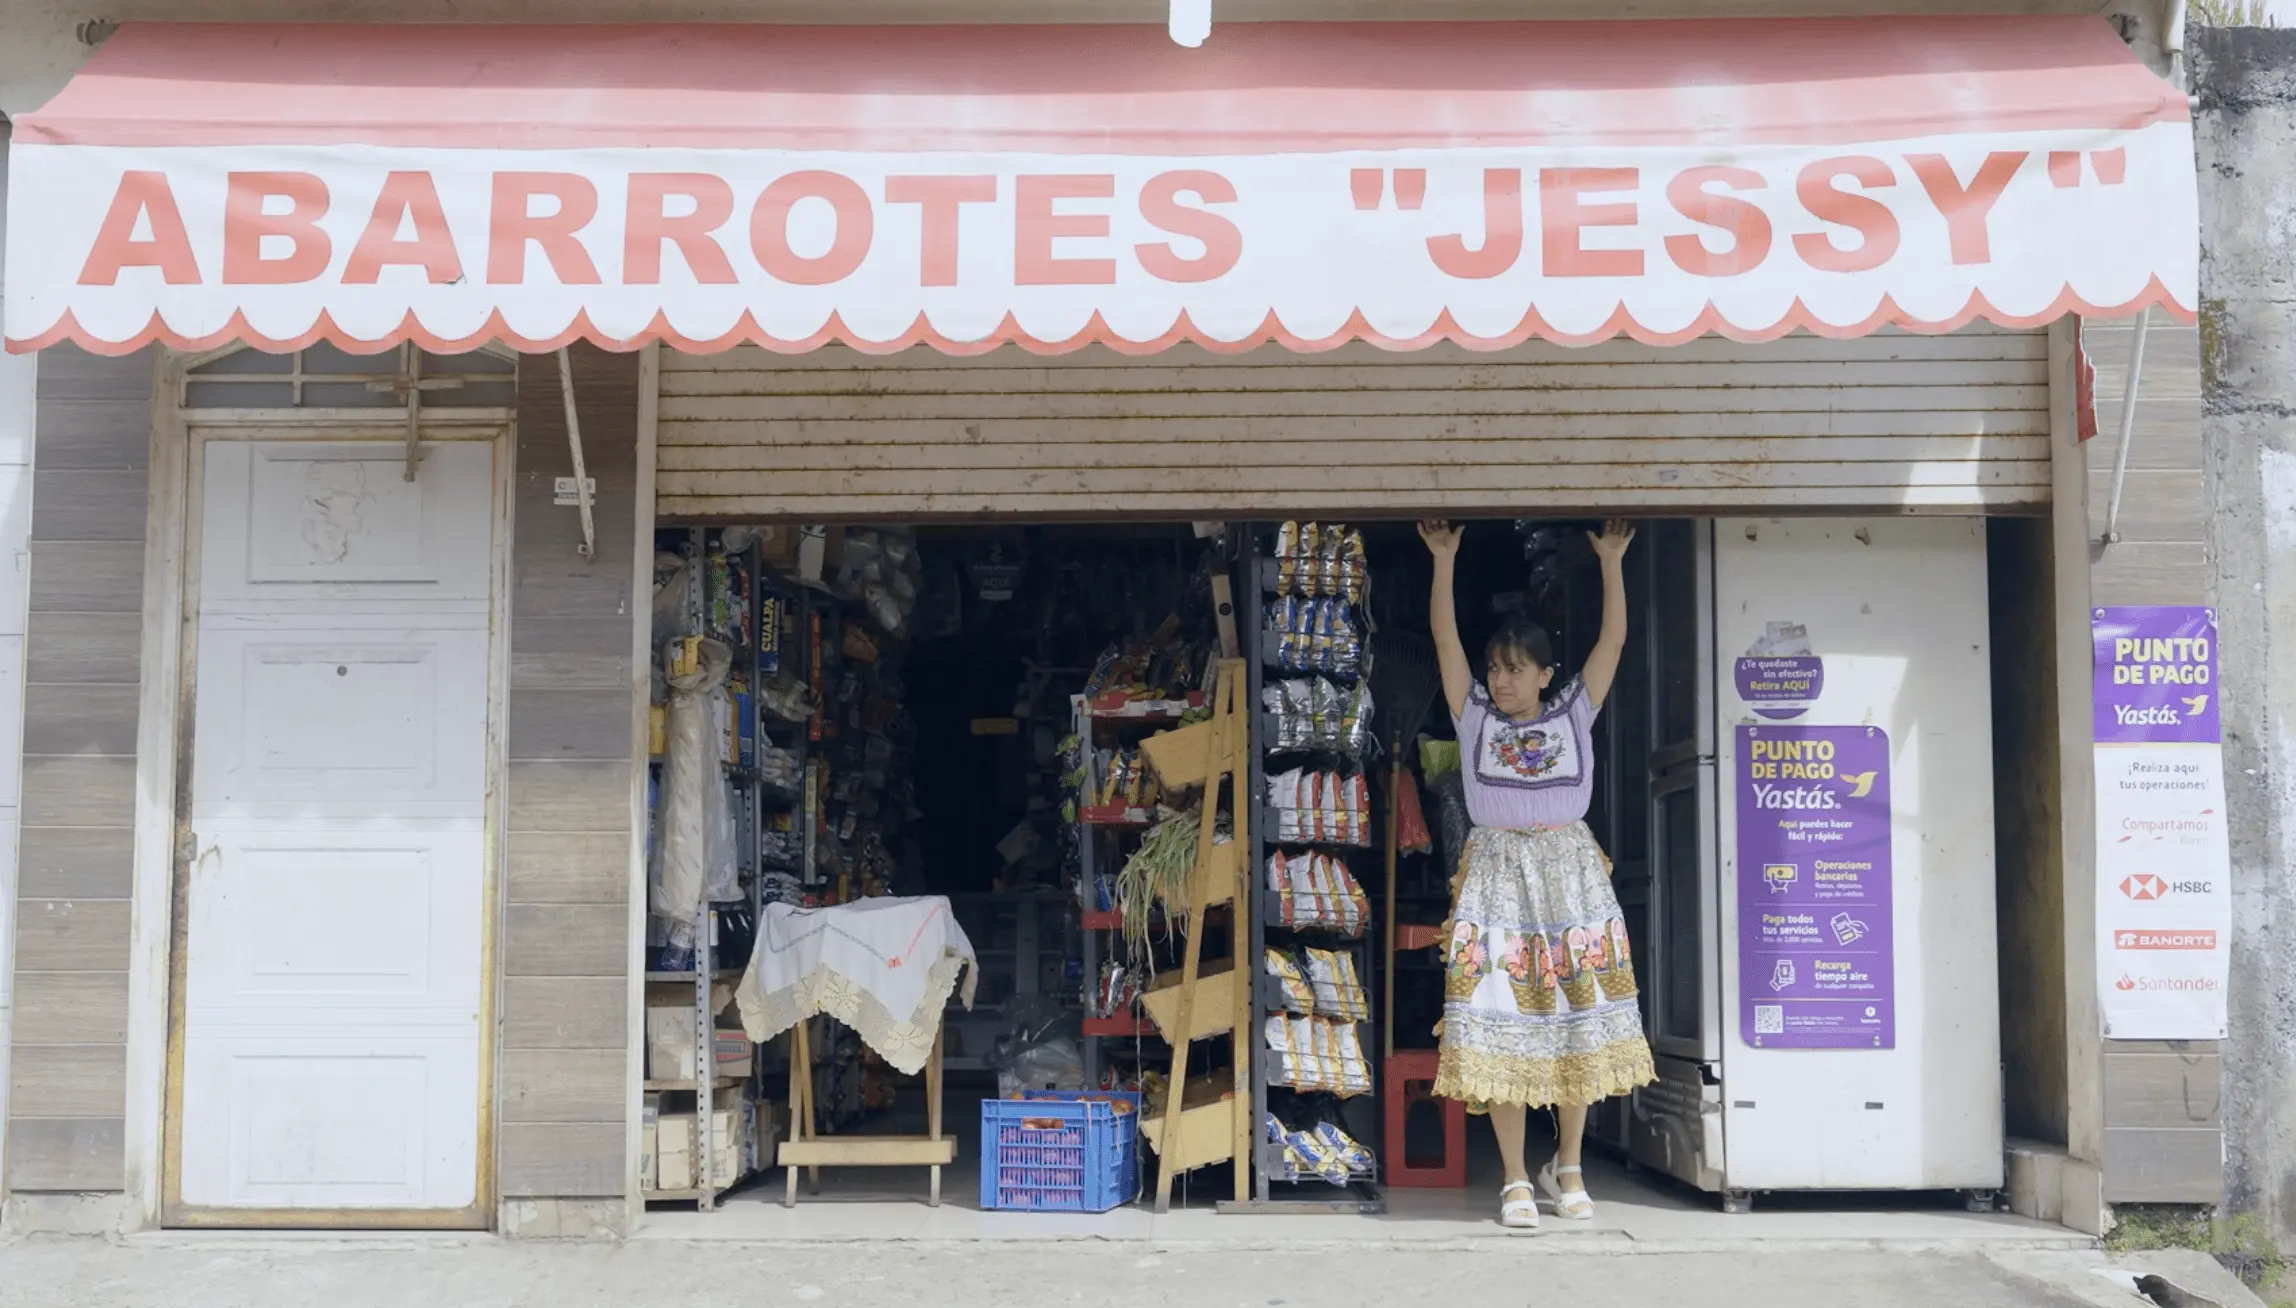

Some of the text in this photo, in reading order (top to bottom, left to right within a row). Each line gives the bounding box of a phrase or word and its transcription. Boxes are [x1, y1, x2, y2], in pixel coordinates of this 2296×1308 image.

[76, 146, 2127, 287] ABARROTES "JESSY"
[760, 597, 776, 653] CUALPA
[2114, 637, 2209, 662] PUNTO
[1741, 659, 1798, 671] ¿Te quedaste
[1763, 668, 1818, 679] sin efectivo?
[2113, 665, 2210, 685] DE PAGO
[1750, 679, 1810, 692] Retira AQUÍ
[1751, 740, 1835, 762] PUNTO
[1751, 763, 1834, 780] DE PAGO
[2128, 762, 2170, 776] ¡Realiza
[2119, 780, 2137, 789] tus
[1778, 819, 1853, 830] Aquí puedes hacer
[2121, 817, 2209, 836] Compartamos
[1788, 831, 1844, 843] fácil y rápido:
[1814, 860, 1872, 873] Operaciones
[1814, 871, 1858, 881] bancarias
[2172, 881, 2212, 894] HSBC
[1787, 913, 1814, 925] todos
[1762, 925, 1819, 935] tus servicios
[2139, 935, 2214, 947] BANORTE
[1814, 960, 1851, 973] Recarga
[1814, 971, 1868, 983] tiempo aire
[2138, 976, 2218, 991] Santander
